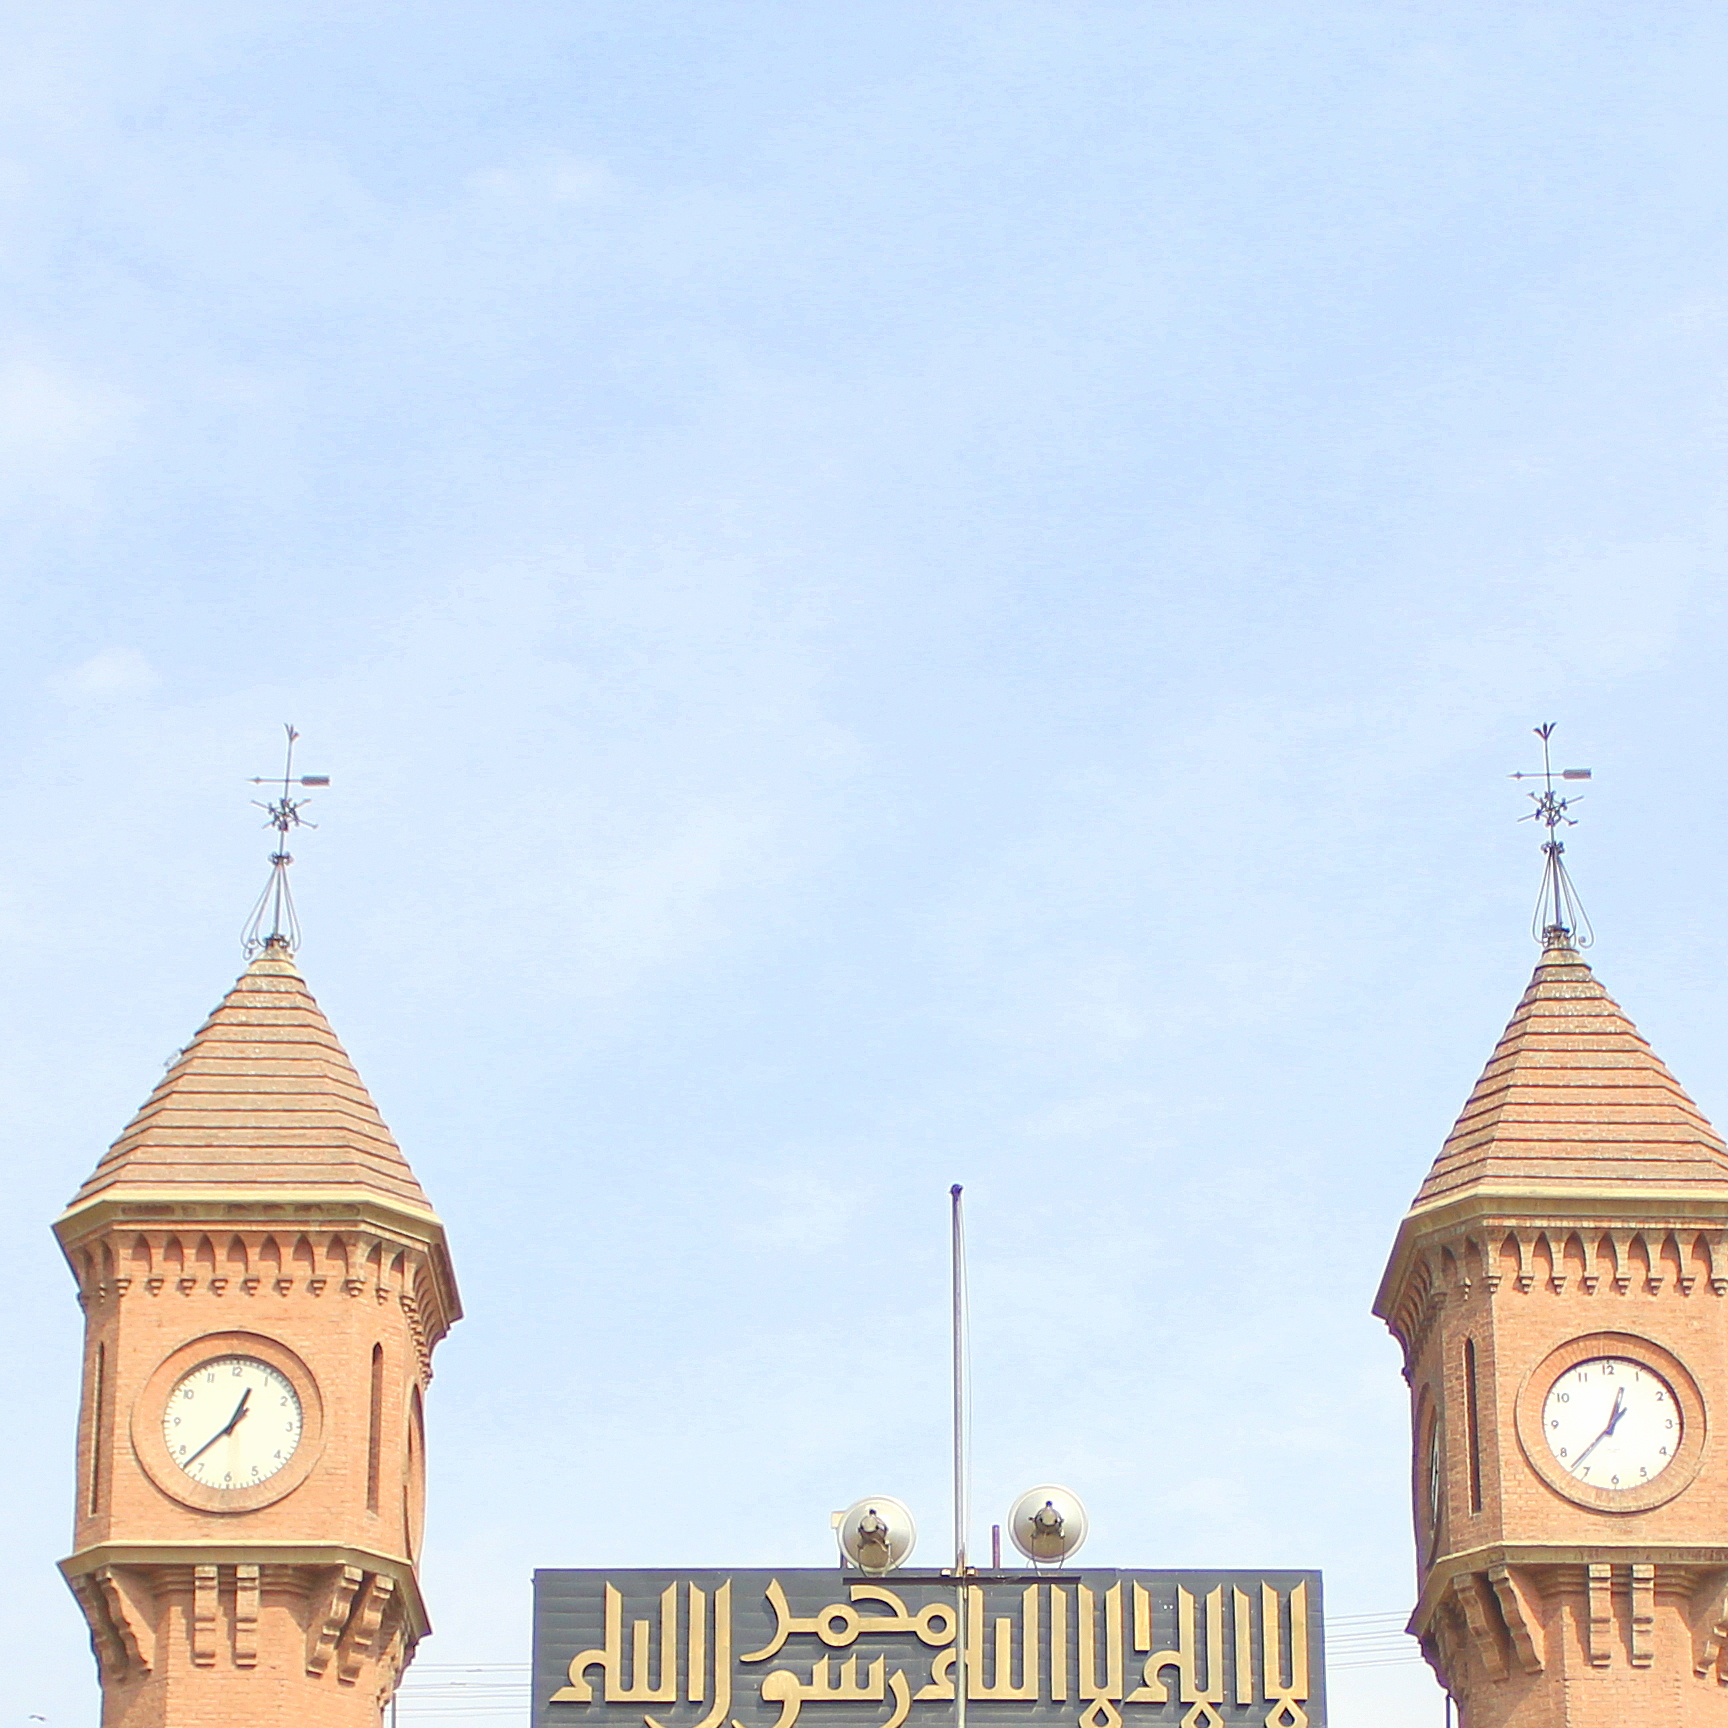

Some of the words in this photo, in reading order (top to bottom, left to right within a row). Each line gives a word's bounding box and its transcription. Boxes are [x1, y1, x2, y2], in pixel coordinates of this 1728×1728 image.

[232, 1366, 243, 1377] 12
[1602, 1365, 1615, 1375] 12
[207, 1373, 215, 1383] 11
[1578, 1372, 1588, 1382] 11
[183, 1389, 194, 1400] 10
[1557, 1393, 1570, 1403] 10
[1655, 1391, 1664, 1401] 2
[280, 1396, 288, 1407] 2
[173, 1417, 181, 1427] 9
[285, 1422, 293, 1432] 3
[1551, 1420, 1559, 1429] 9
[1665, 1419, 1673, 1429] 3
[179, 1445, 186, 1455] 8
[274, 1449, 281, 1459] 4
[1560, 1447, 1567, 1457] 8
[1659, 1446, 1667, 1456] 4
[198, 1463, 205, 1473] 7
[251, 1466, 259, 1476] 5
[1583, 1466, 1591, 1477] 7
[1640, 1467, 1647, 1477] 5
[224, 1471, 232, 1482] 6
[1611, 1475, 1619, 1484] 6
[739, 1578, 957, 1662] محمد
[549, 1580, 706, 1702] الله
[913, 1583, 1068, 1701] الله
